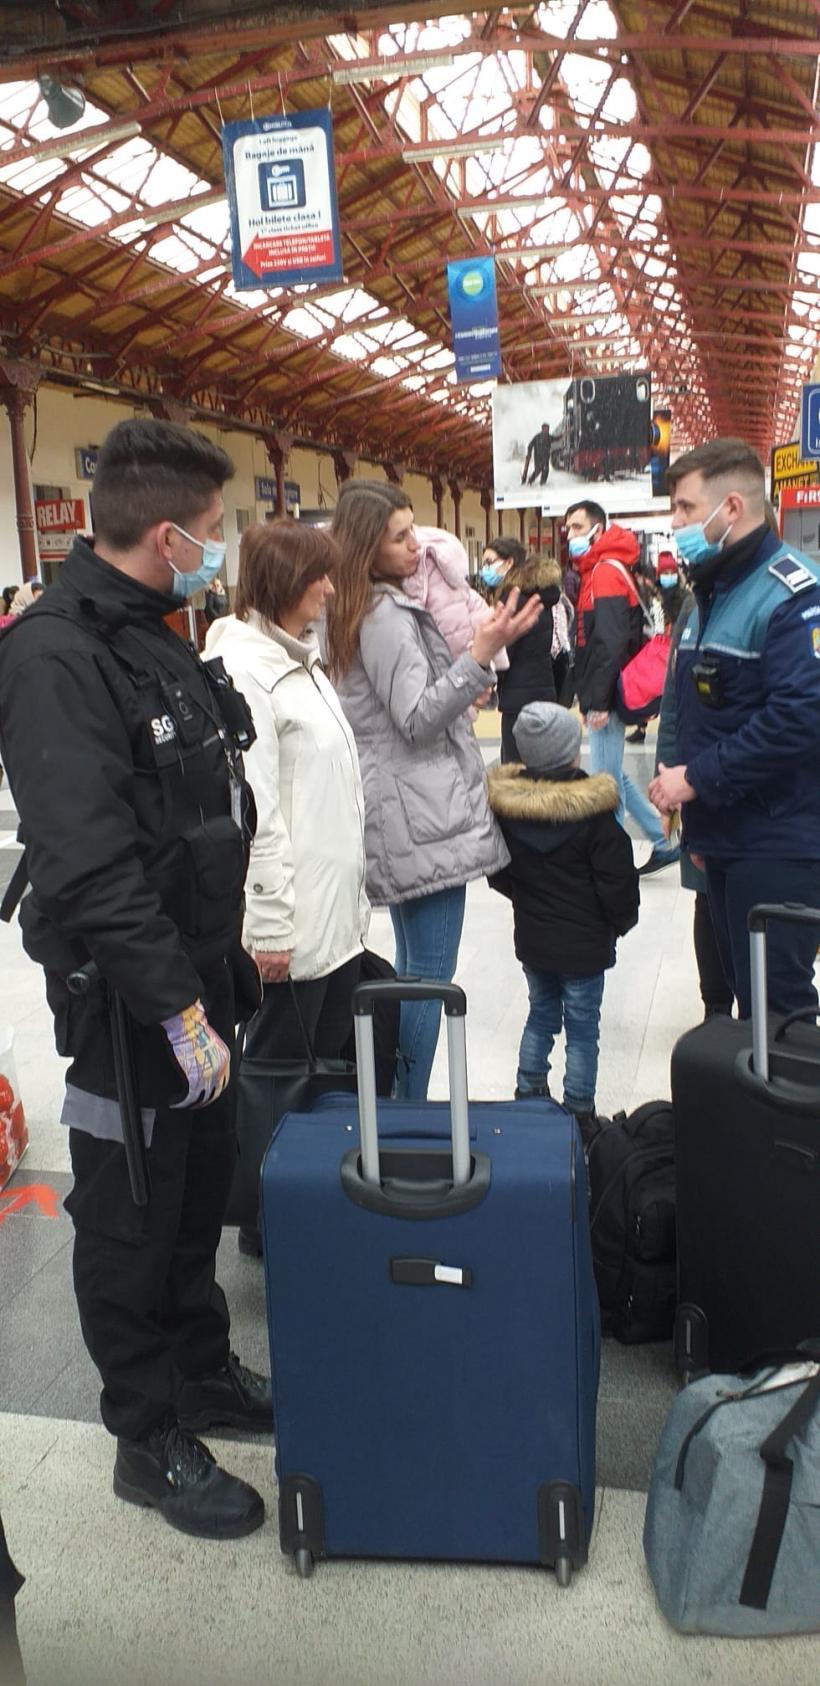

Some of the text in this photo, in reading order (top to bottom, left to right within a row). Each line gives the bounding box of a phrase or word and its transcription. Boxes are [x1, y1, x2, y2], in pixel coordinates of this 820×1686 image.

[245, 149, 275, 159] Bagaje
[277, 147, 287, 155] de
[249, 216, 263, 227] Hol
[265, 213, 291, 225] bilete
[293, 211, 316, 221] clasa
[37, 501, 76, 528] RELAY
[151, 715, 174, 737] SG
